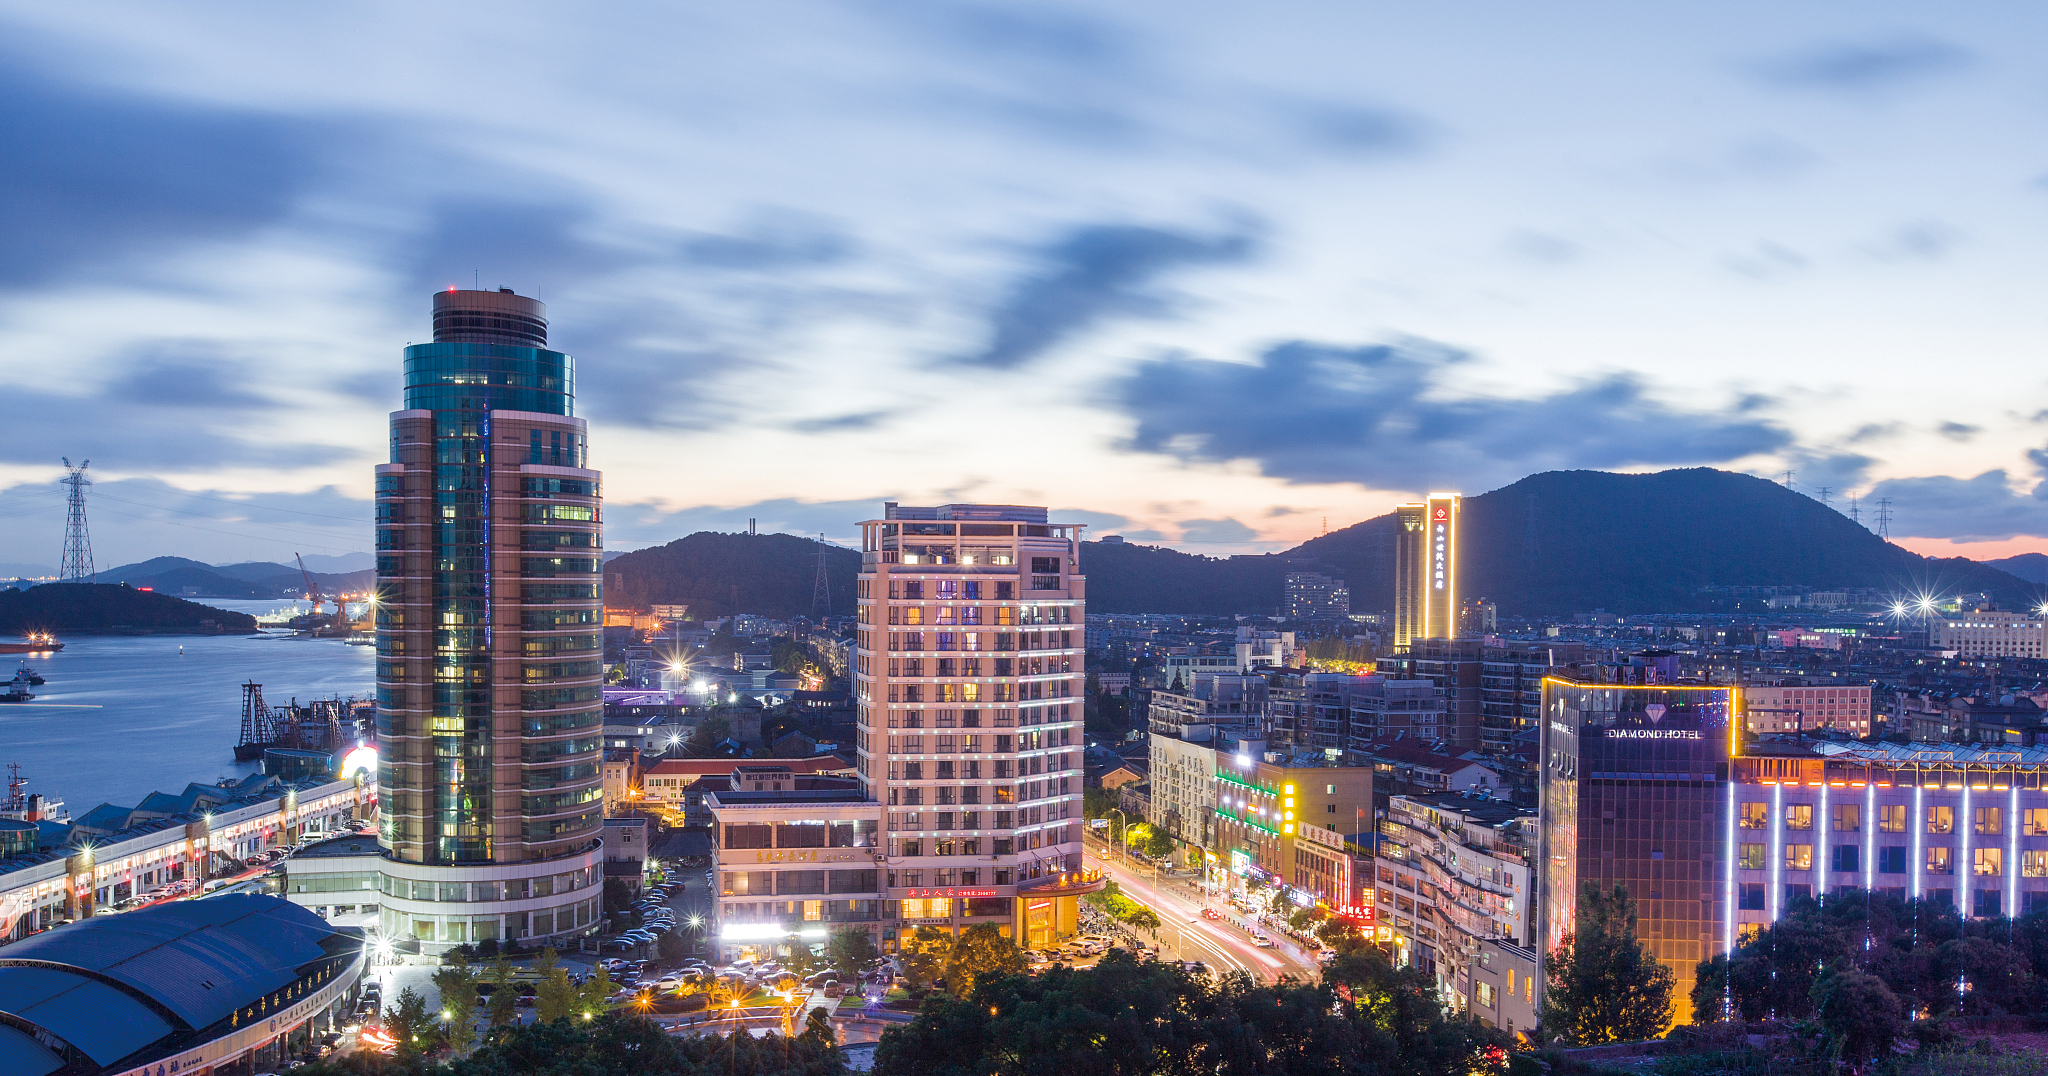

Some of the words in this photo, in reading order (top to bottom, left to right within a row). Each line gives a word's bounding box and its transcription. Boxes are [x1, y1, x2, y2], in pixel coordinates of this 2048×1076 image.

[1608, 729, 1662, 739] DIAMOND
[1664, 730, 1699, 739] HOTEL
[908, 888, 954, 898] 舟山人家
